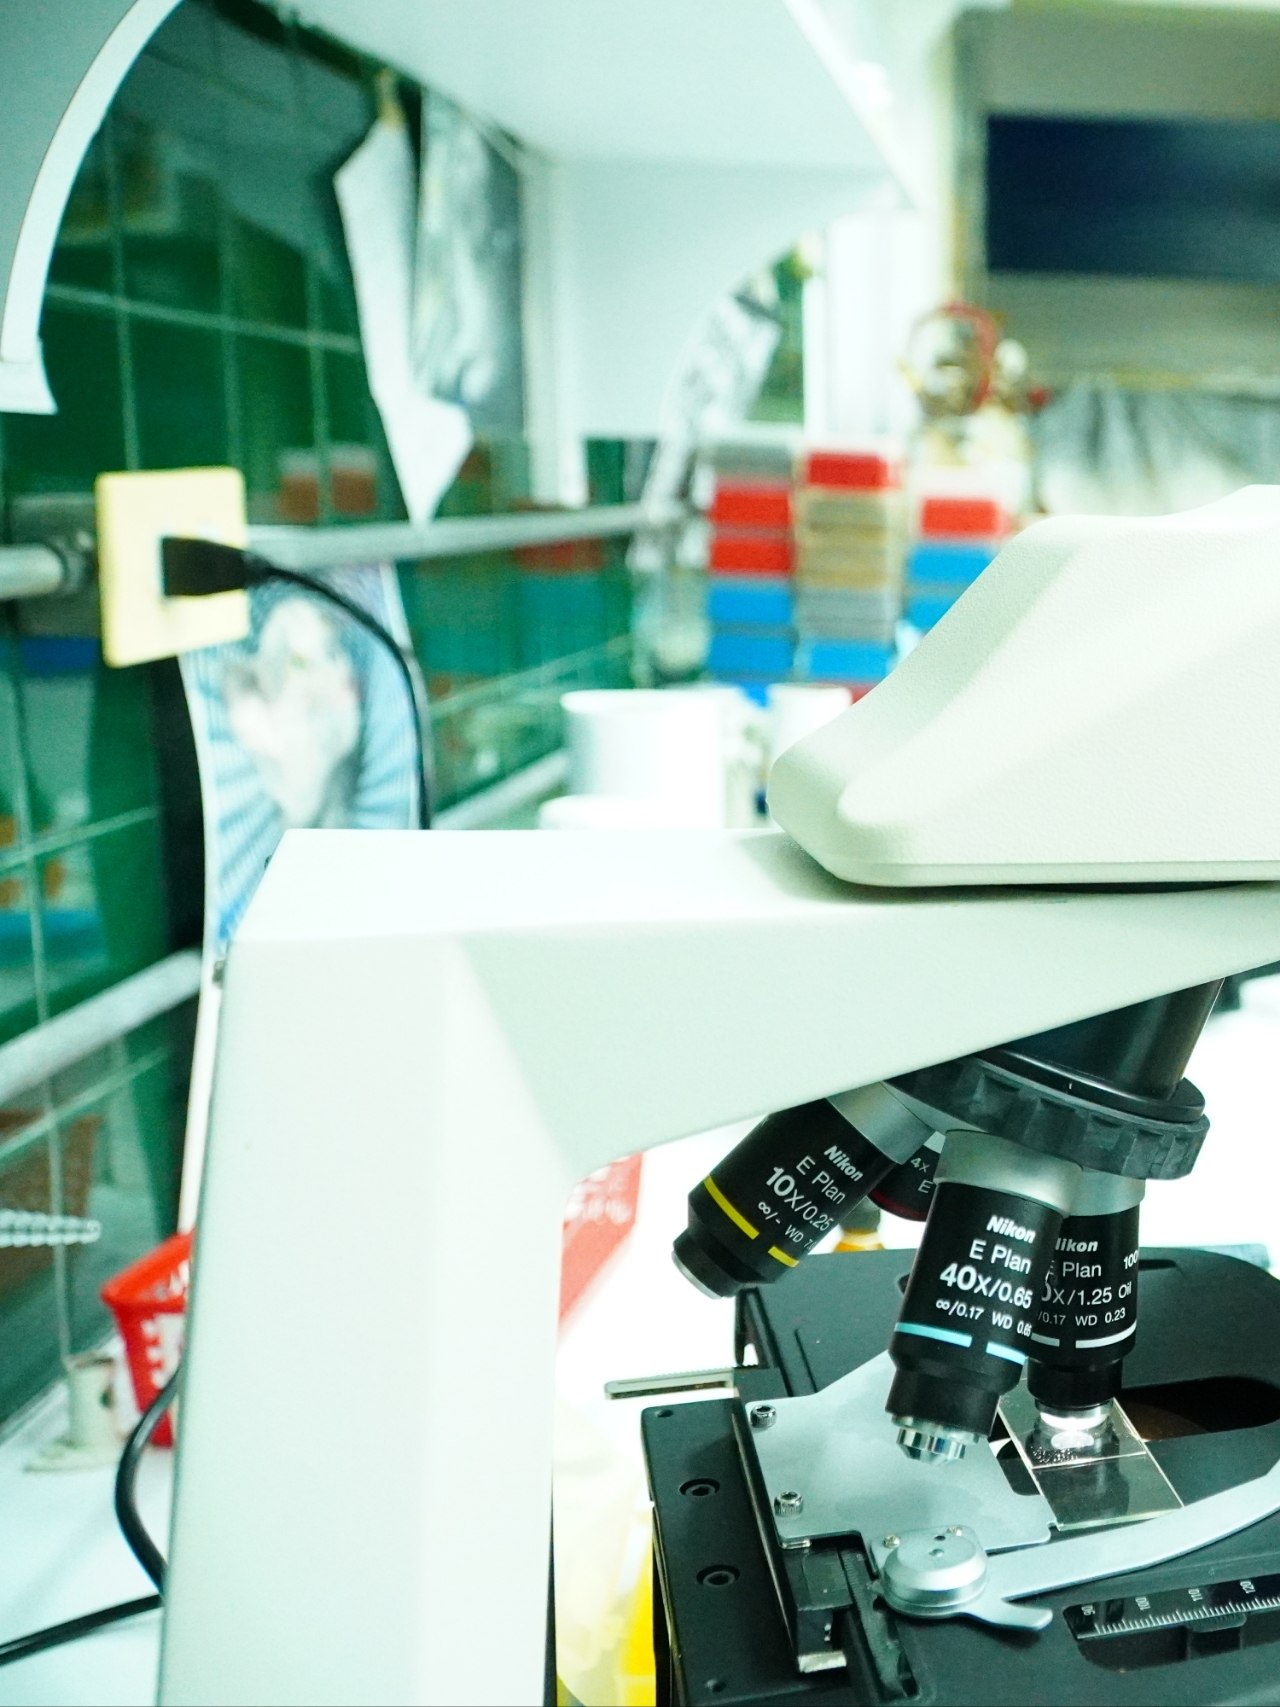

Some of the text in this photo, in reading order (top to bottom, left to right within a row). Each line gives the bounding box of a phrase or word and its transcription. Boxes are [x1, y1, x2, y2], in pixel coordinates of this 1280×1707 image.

[823, 1144, 864, 1182] Nikon
[795, 1155, 846, 1205] E Plan
[784, 1224, 805, 1243] WD
[986, 1214, 1037, 1245] Nikon
[968, 1238, 987, 1261] E
[990, 1243, 1032, 1275] Plan
[1062, 1261, 1102, 1278] Plan
[1118, 1281, 1132, 1299] Oil
[992, 1310, 1013, 1335] WD
[1037, 1307, 1126, 1327] /0.17 WD 0.23
[1239, 1580, 1256, 1595] 120
